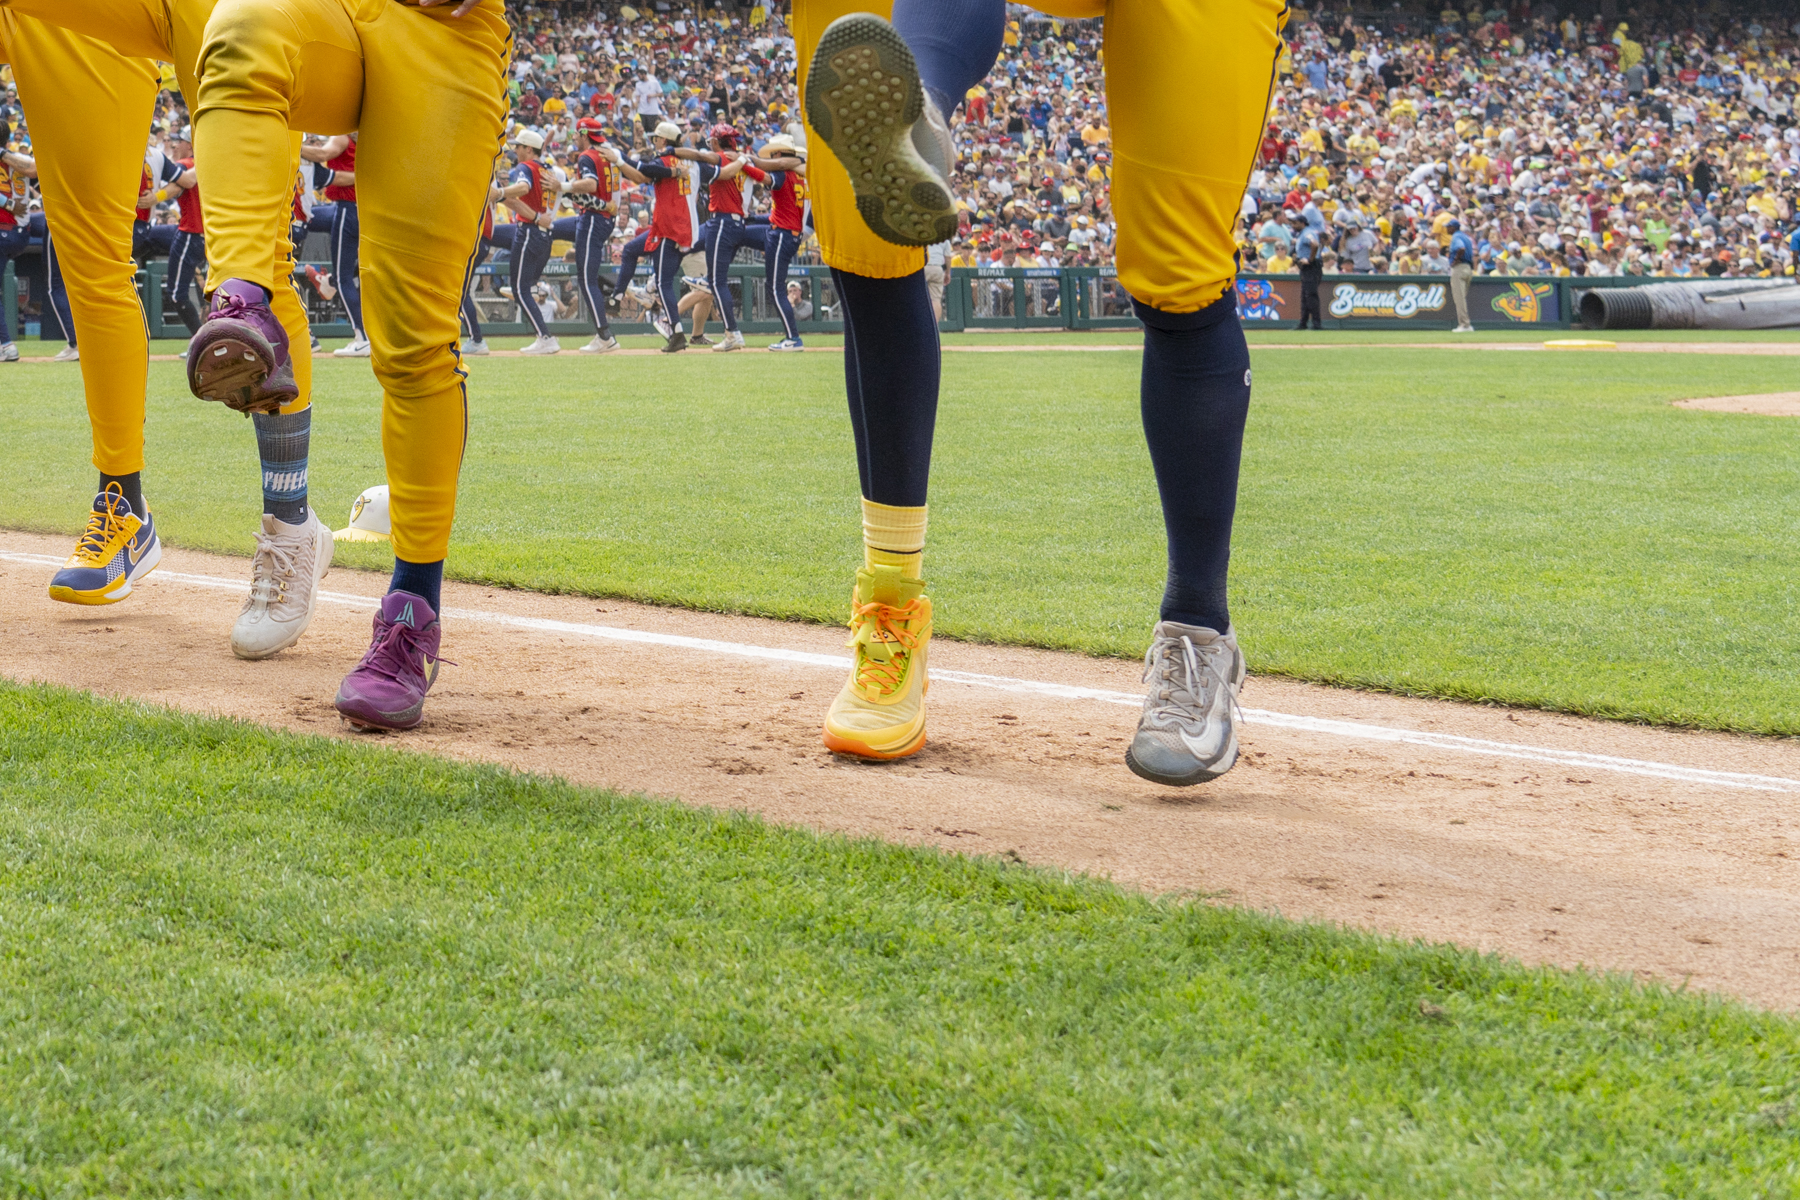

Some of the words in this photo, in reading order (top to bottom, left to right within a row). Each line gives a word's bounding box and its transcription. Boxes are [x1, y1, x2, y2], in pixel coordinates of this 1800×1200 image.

[978, 268, 1005, 277] RE/MAX
[1099, 268, 1117, 276] RE/MA
[1330, 284, 1398, 317] Banana
[1395, 284, 1445, 317] Ball
